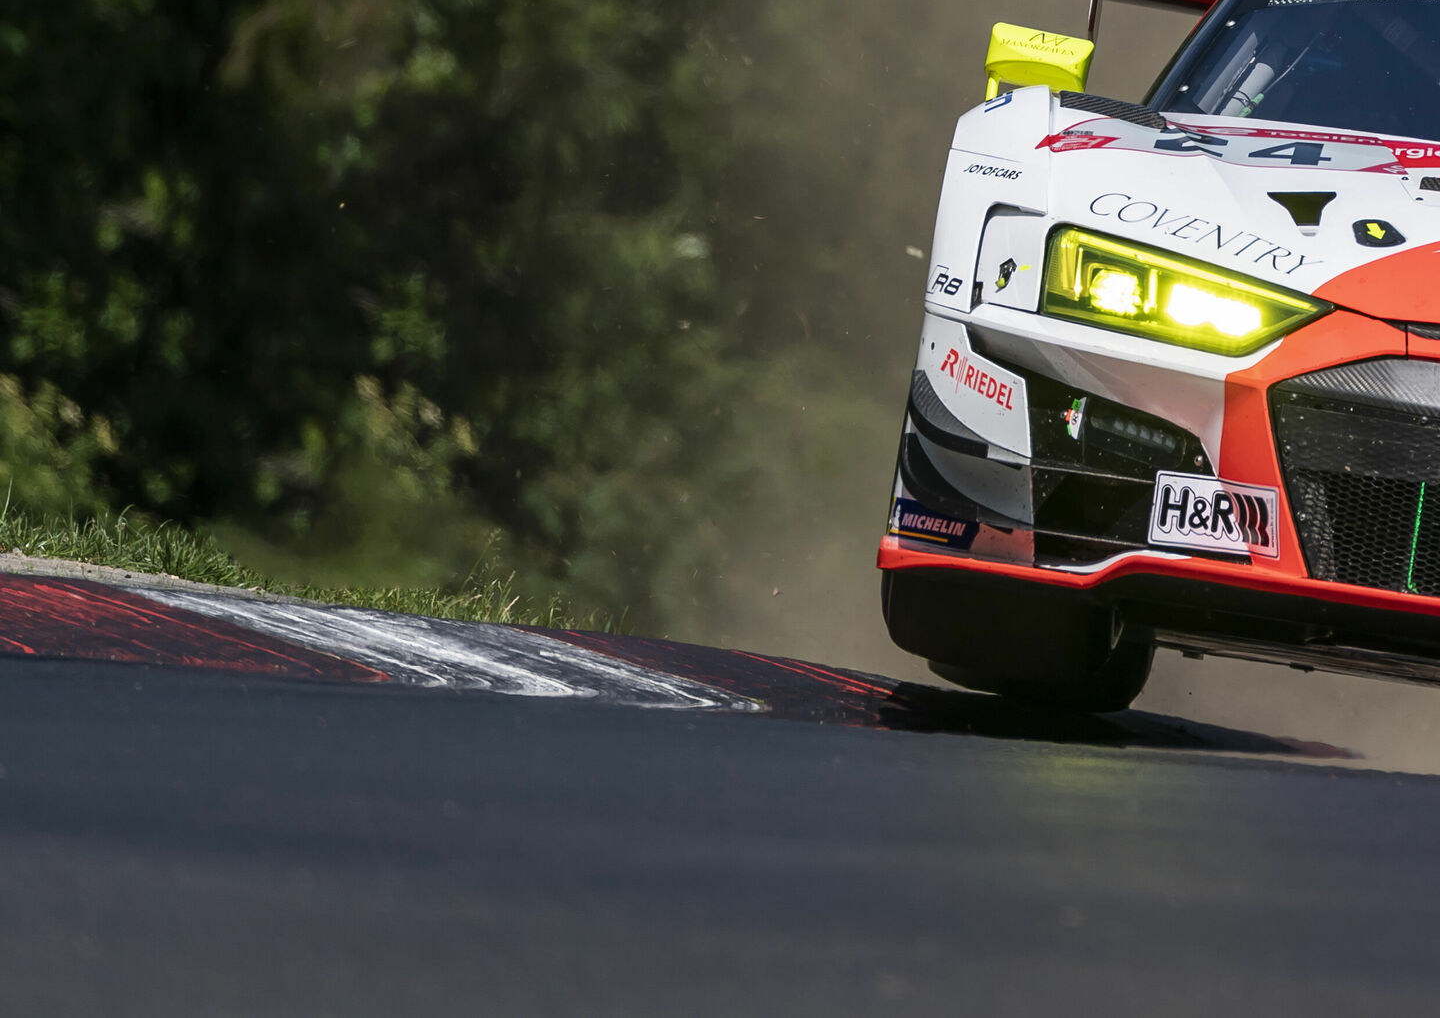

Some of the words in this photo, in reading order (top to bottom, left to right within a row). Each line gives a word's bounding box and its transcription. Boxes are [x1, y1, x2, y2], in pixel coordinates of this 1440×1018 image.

[1089, 192, 1324, 275] COVENTRY
[931, 271, 964, 296] R8
[964, 364, 1013, 411] RIEDEL
[901, 512, 967, 537] MICHELIN
[1157, 484, 1240, 541] H&R
